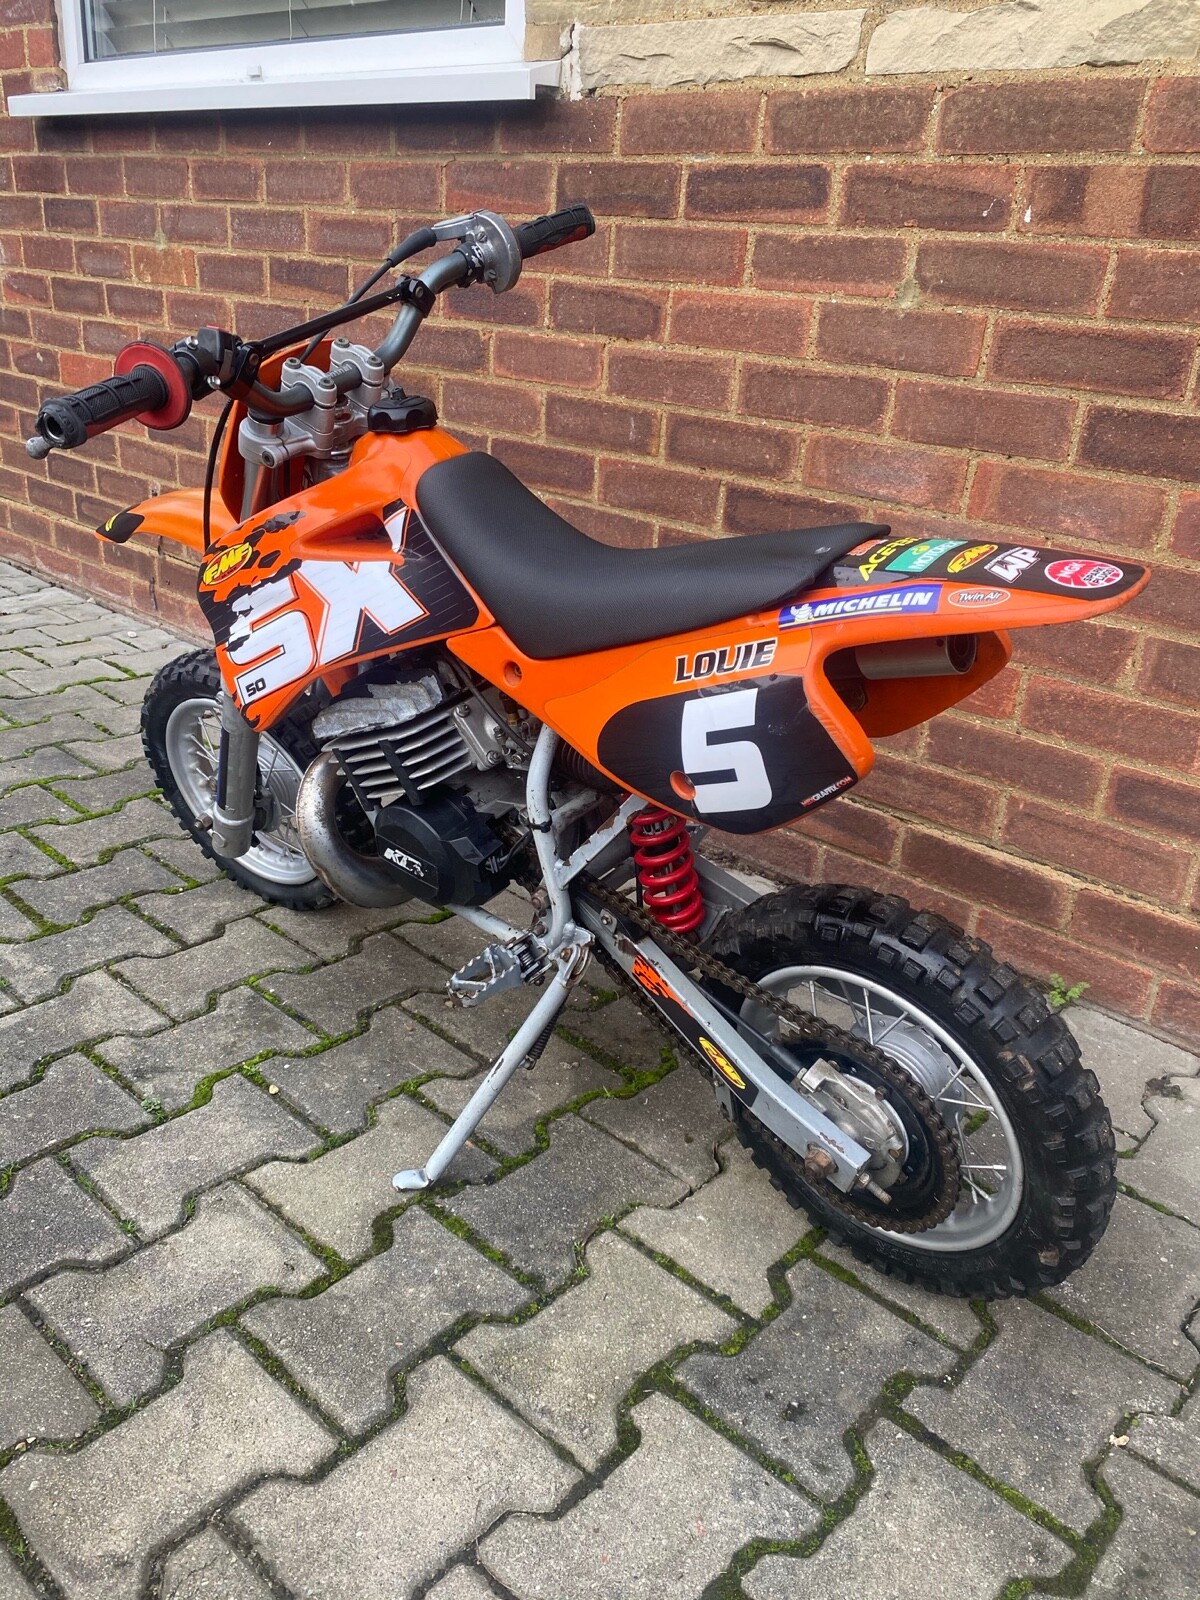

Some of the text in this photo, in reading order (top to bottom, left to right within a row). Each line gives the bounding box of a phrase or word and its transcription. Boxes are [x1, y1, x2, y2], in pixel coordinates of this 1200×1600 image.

[204, 542, 251, 584] FMF
[990, 548, 1040, 582] WP
[1056, 562, 1086, 578] NGK
[226, 508, 430, 705] SX
[814, 592, 934, 617] MICHELIN
[958, 591, 983, 601] Twin
[984, 591, 1002, 601] Air
[674, 638, 777, 683] LOUIE
[245, 677, 267, 697] 50
[681, 688, 772, 813] 5
